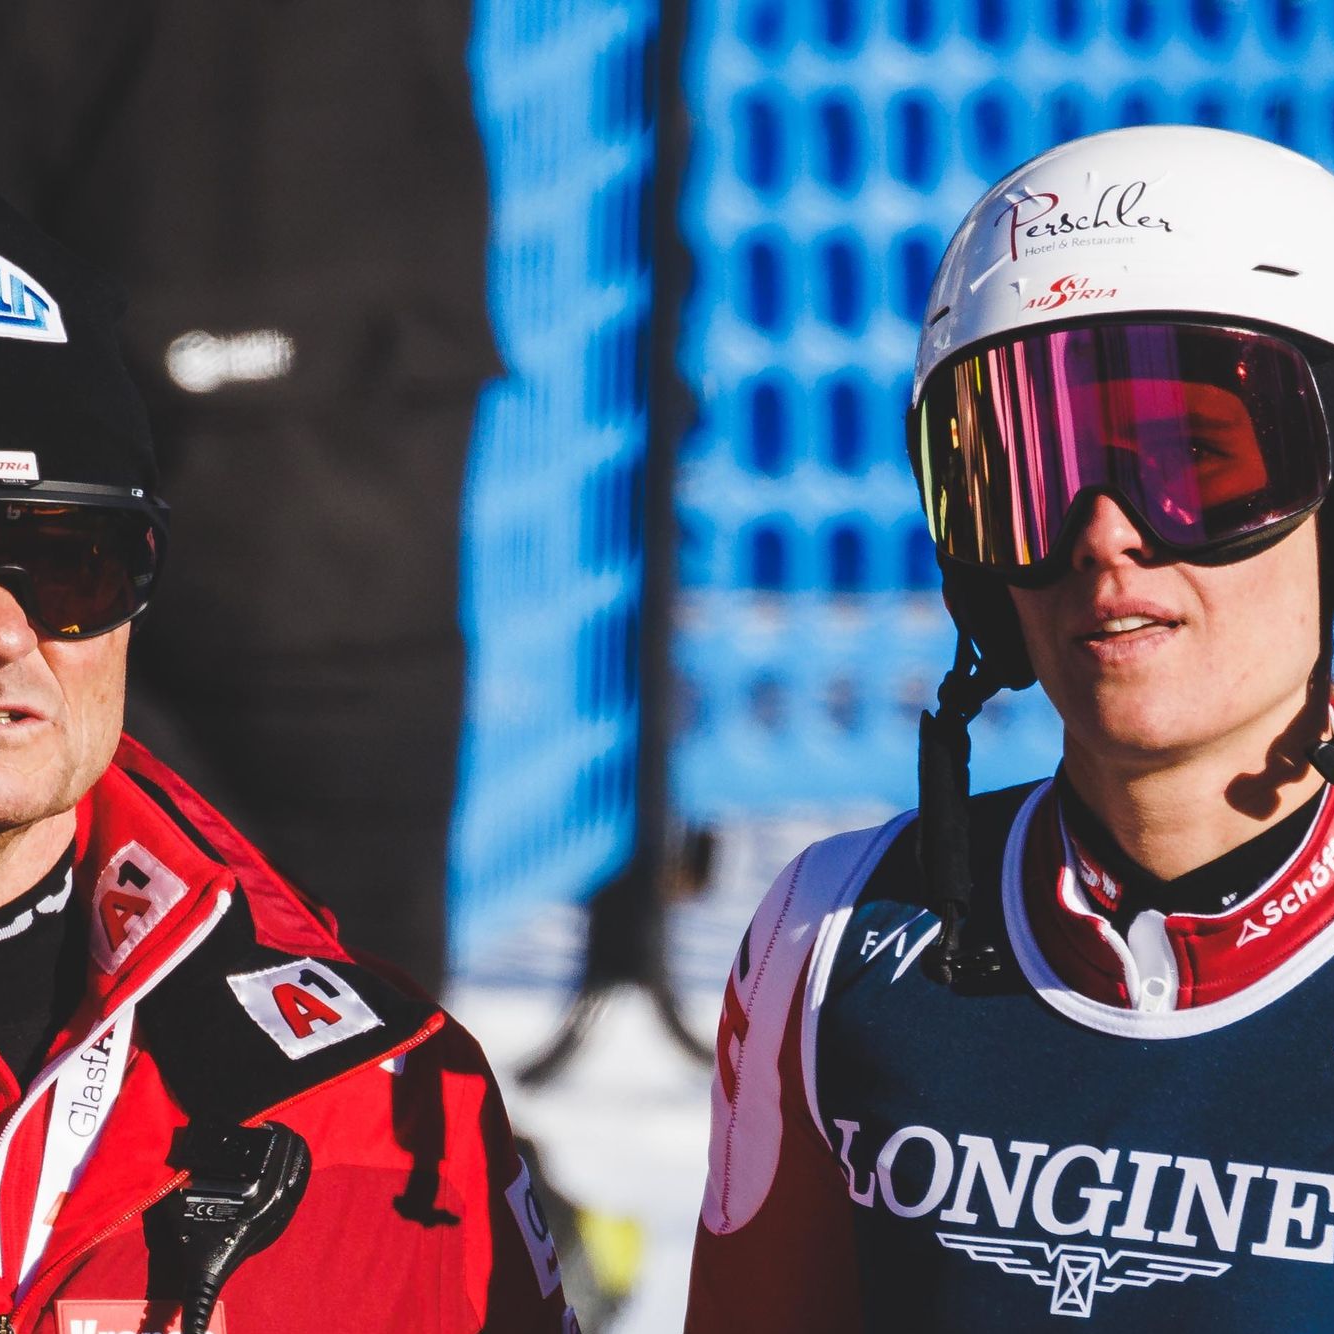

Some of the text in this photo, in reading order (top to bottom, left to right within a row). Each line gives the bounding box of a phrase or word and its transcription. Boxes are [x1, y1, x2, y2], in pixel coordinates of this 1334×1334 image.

[994, 181, 1173, 262] Perschler
[1025, 236, 1136, 257] Hotel & Restaurant
[99, 859, 152, 953] A1
[272, 969, 342, 1040] A1
